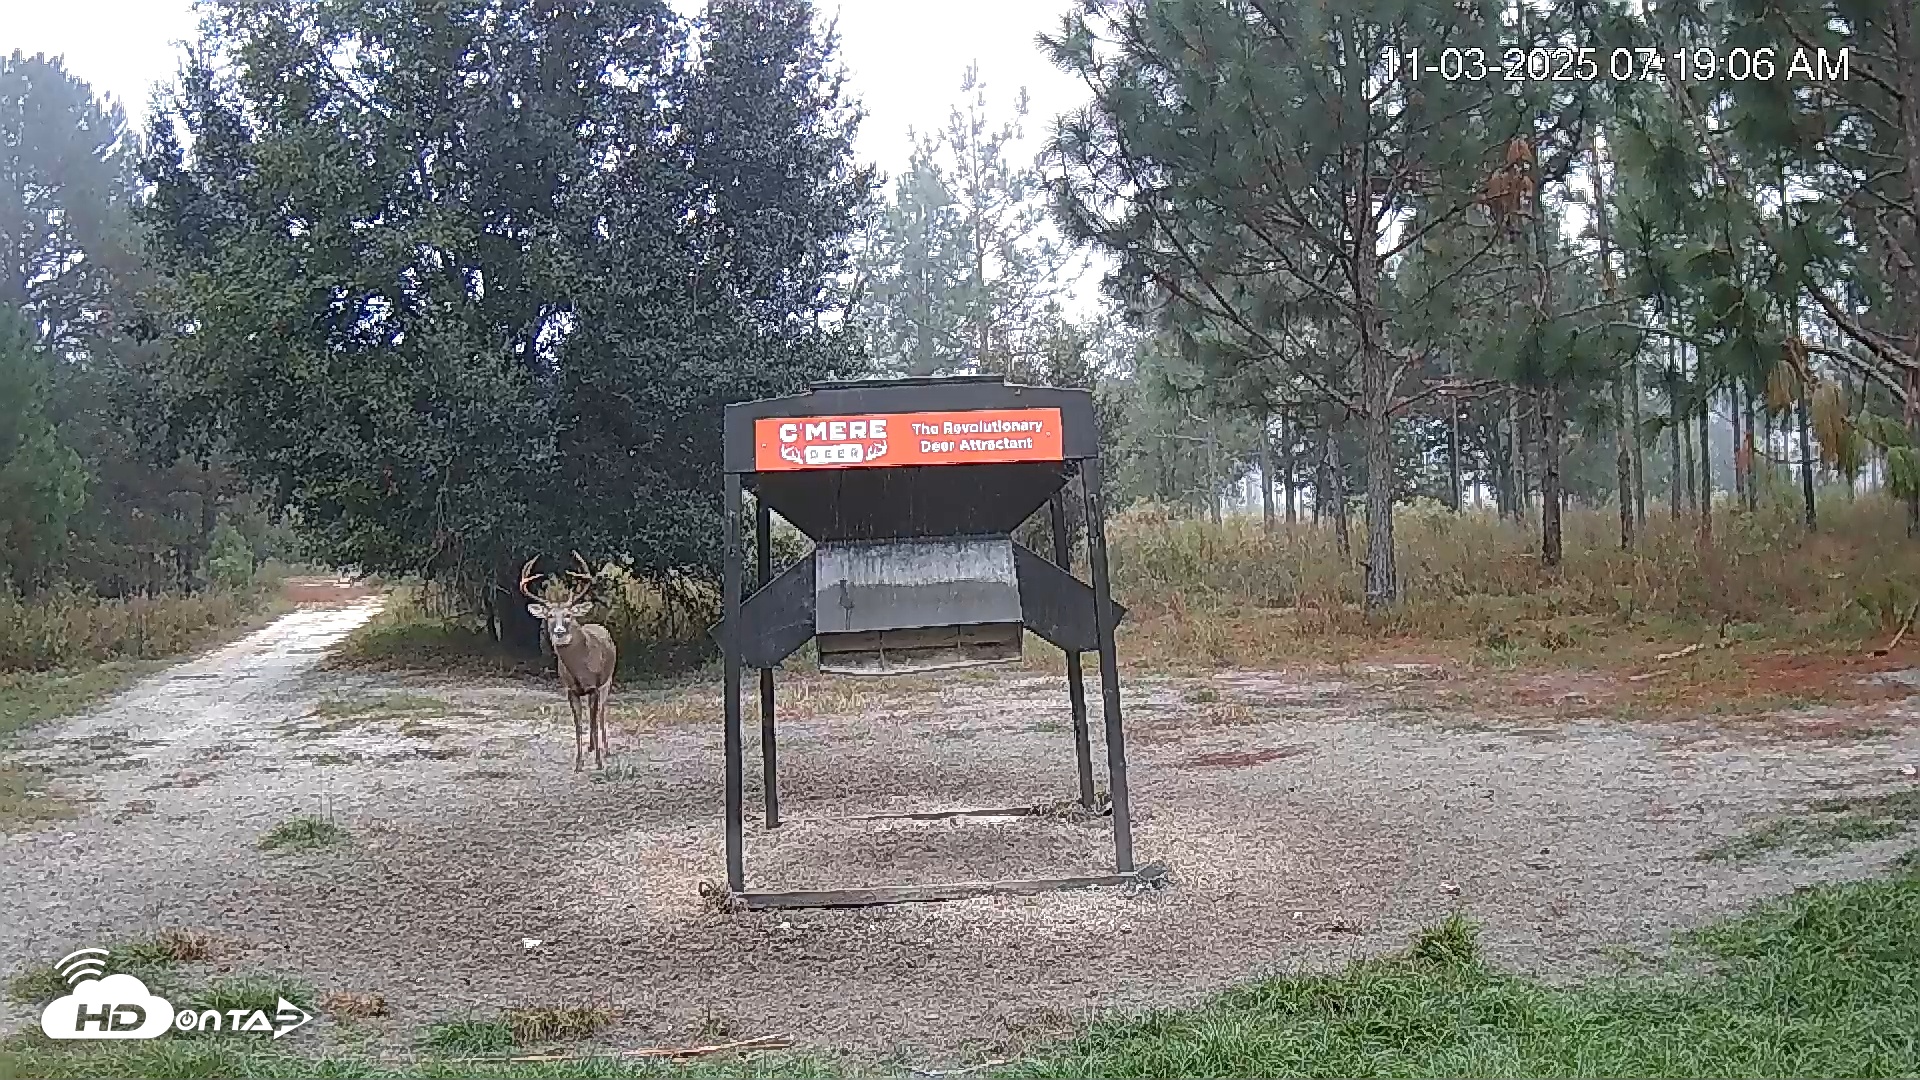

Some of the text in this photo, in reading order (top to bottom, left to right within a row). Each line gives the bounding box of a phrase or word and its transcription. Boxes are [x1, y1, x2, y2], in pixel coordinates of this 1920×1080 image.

[779, 419, 887, 443] C'MERE
[911, 420, 1043, 436] The Revolutionary
[809, 447, 859, 459] DEER
[920, 437, 1033, 453] Deer Attractant
